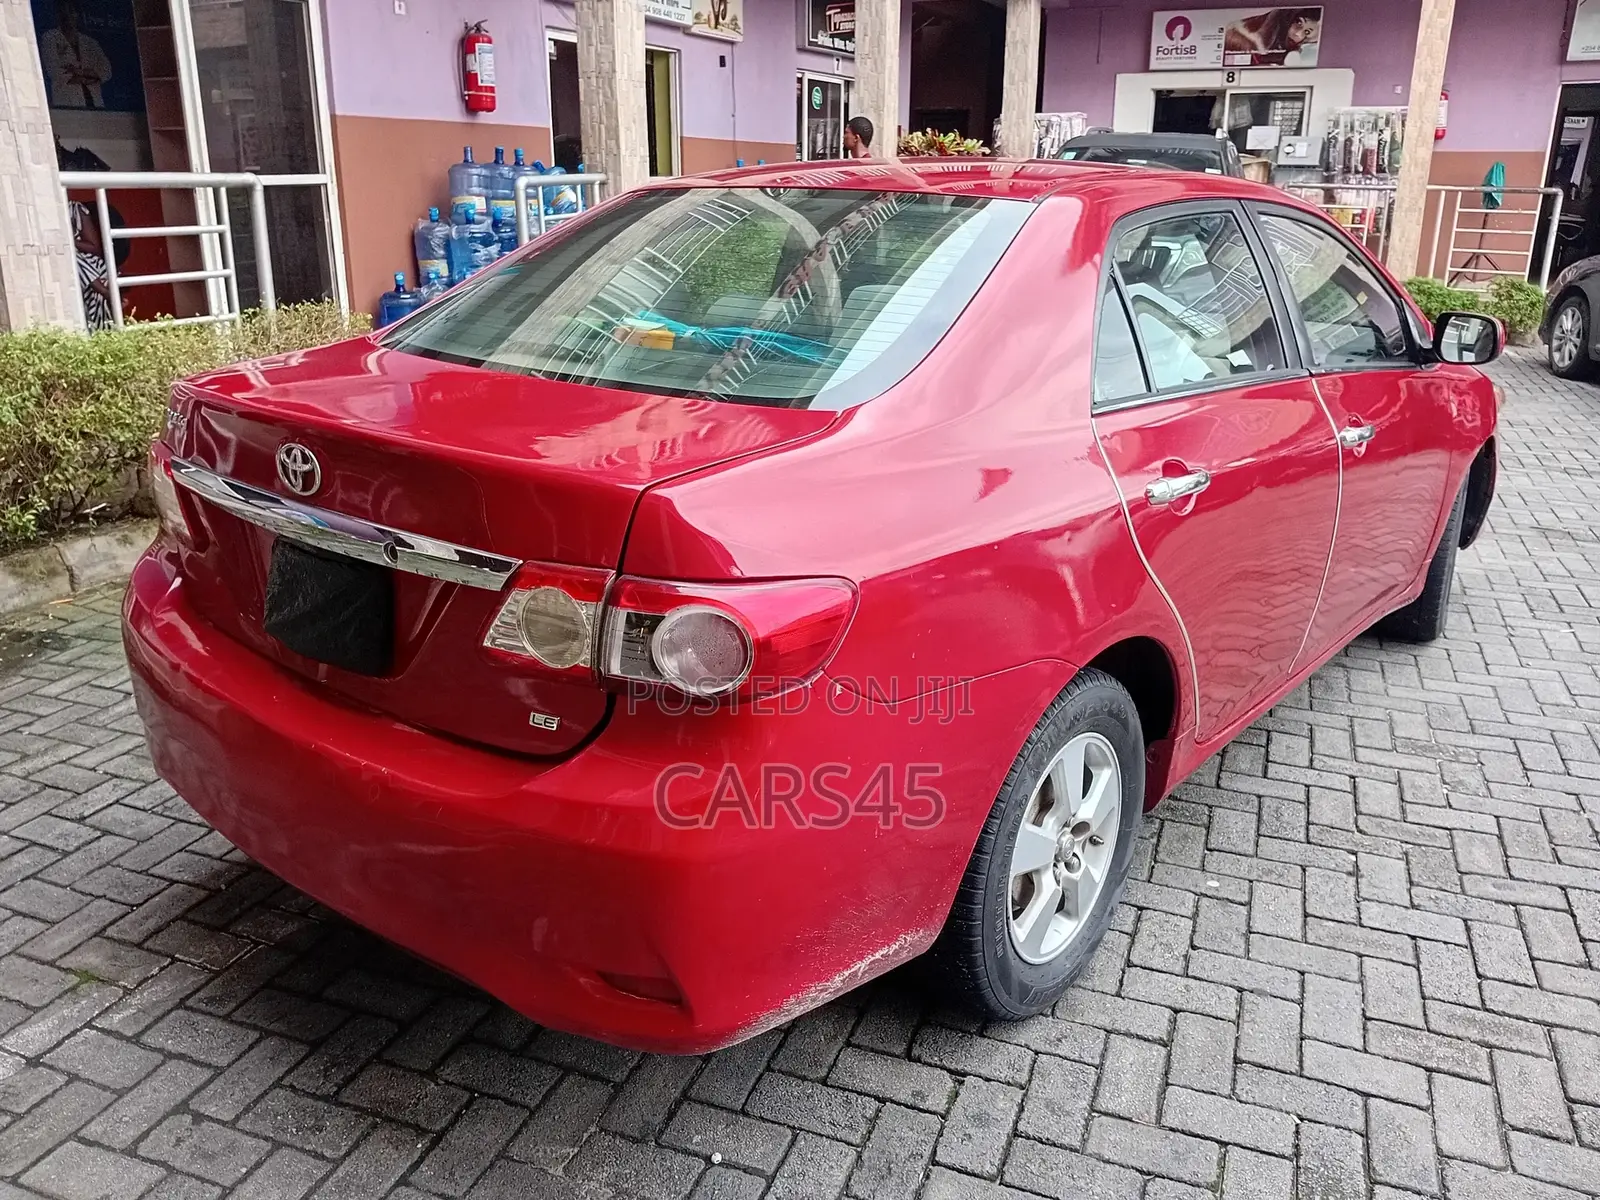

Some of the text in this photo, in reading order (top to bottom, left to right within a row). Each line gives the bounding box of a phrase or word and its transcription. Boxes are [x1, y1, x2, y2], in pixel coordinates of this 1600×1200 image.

[1156, 45, 1197, 56] FortisB
[835, 58, 840, 70] 7
[1226, 72, 1236, 83] 8
[530, 712, 558, 730] LE
